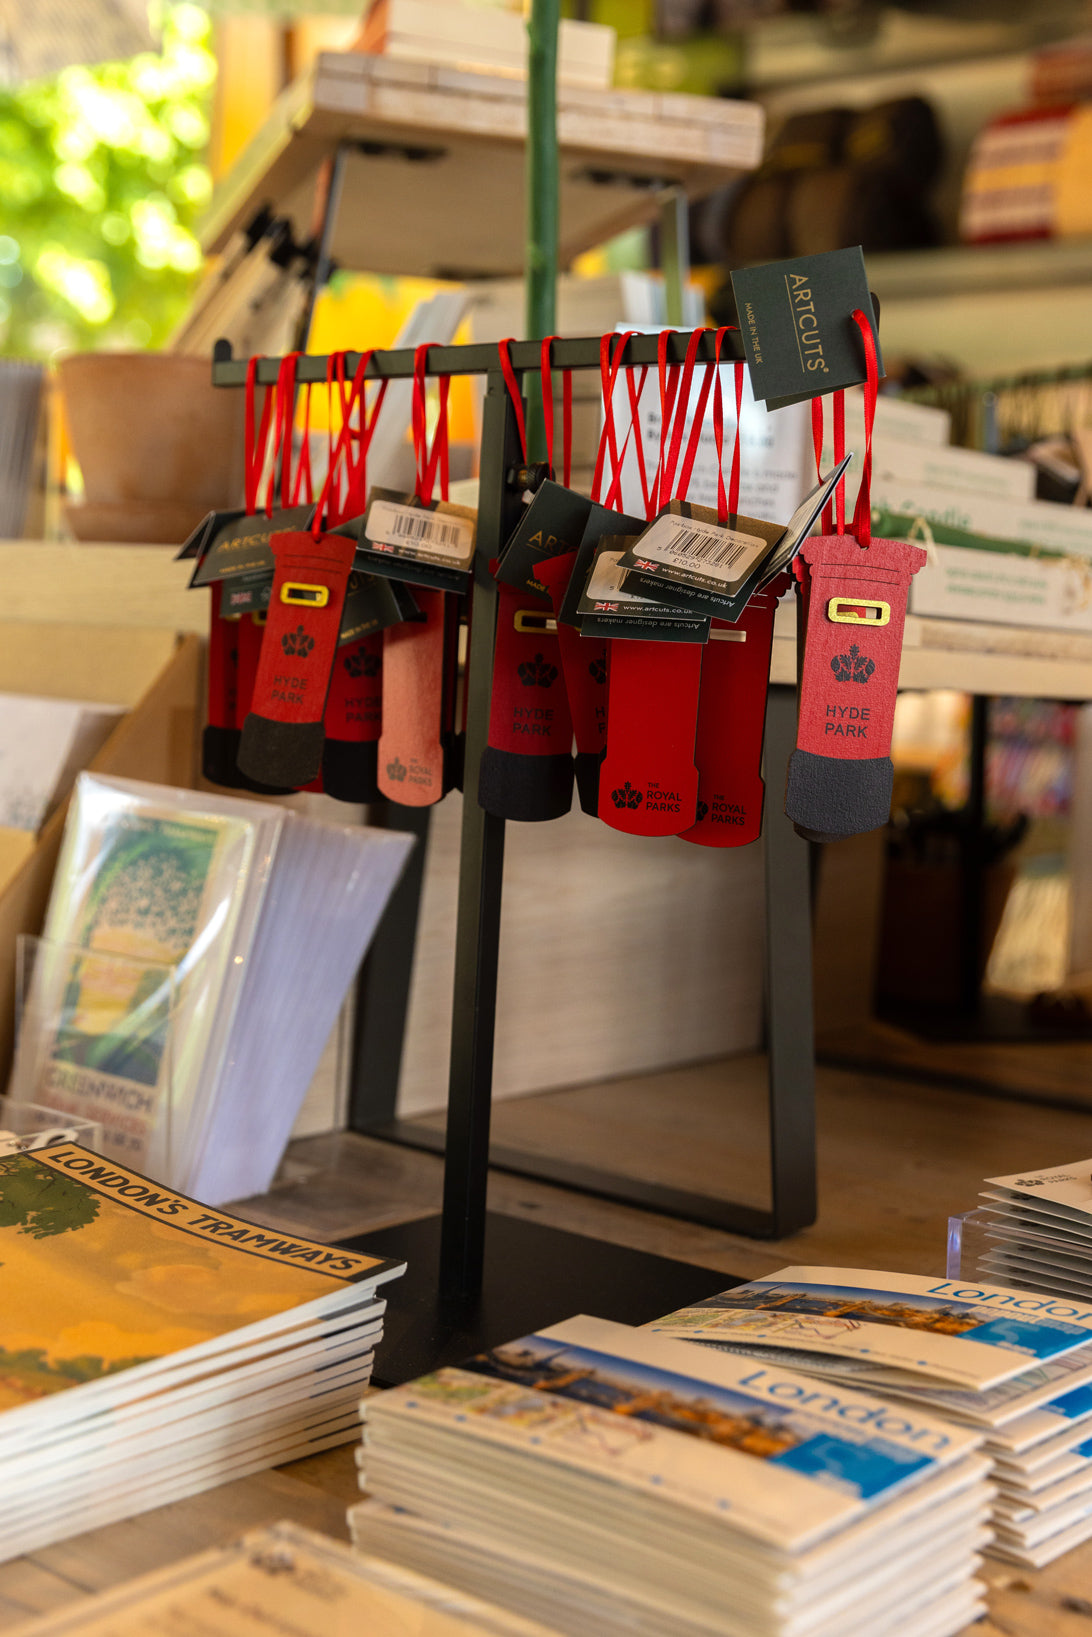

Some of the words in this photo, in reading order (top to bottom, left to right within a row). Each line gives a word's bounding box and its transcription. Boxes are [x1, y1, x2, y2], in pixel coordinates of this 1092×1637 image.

[745, 303, 755, 325] MADE
[750, 326, 758, 335] IN
[752, 337, 761, 351] THE
[755, 353, 763, 364] UK
[672, 558, 701, 570] £10.00
[640, 577, 664, 588] makers
[662, 567, 728, 588] www.artcuts.co.uk
[666, 584, 696, 598] designer
[697, 592, 710, 600] are
[710, 596, 736, 608] Artcuts
[623, 605, 694, 615] www.artcuts.co.uk
[624, 618, 658, 628] designer
[674, 622, 700, 630] Artcuts
[273, 675, 308, 690] HYDE
[271, 690, 304, 704] PARK
[513, 706, 554, 721] HYDE
[826, 704, 870, 720] HYDE
[512, 722, 552, 736] PARK
[825, 722, 868, 738] PARK
[408, 764, 432, 776] ROYAL
[408, 775, 432, 786] PARKS
[646, 790, 682, 802] ROYAL
[646, 802, 681, 813] PARKS
[712, 802, 746, 814] ROYAL
[712, 814, 745, 826] PARKS
[48, 1150, 190, 1216] LONDON'S
[188, 1214, 363, 1272] TRAMWAYS
[738, 1370, 950, 1451] London
